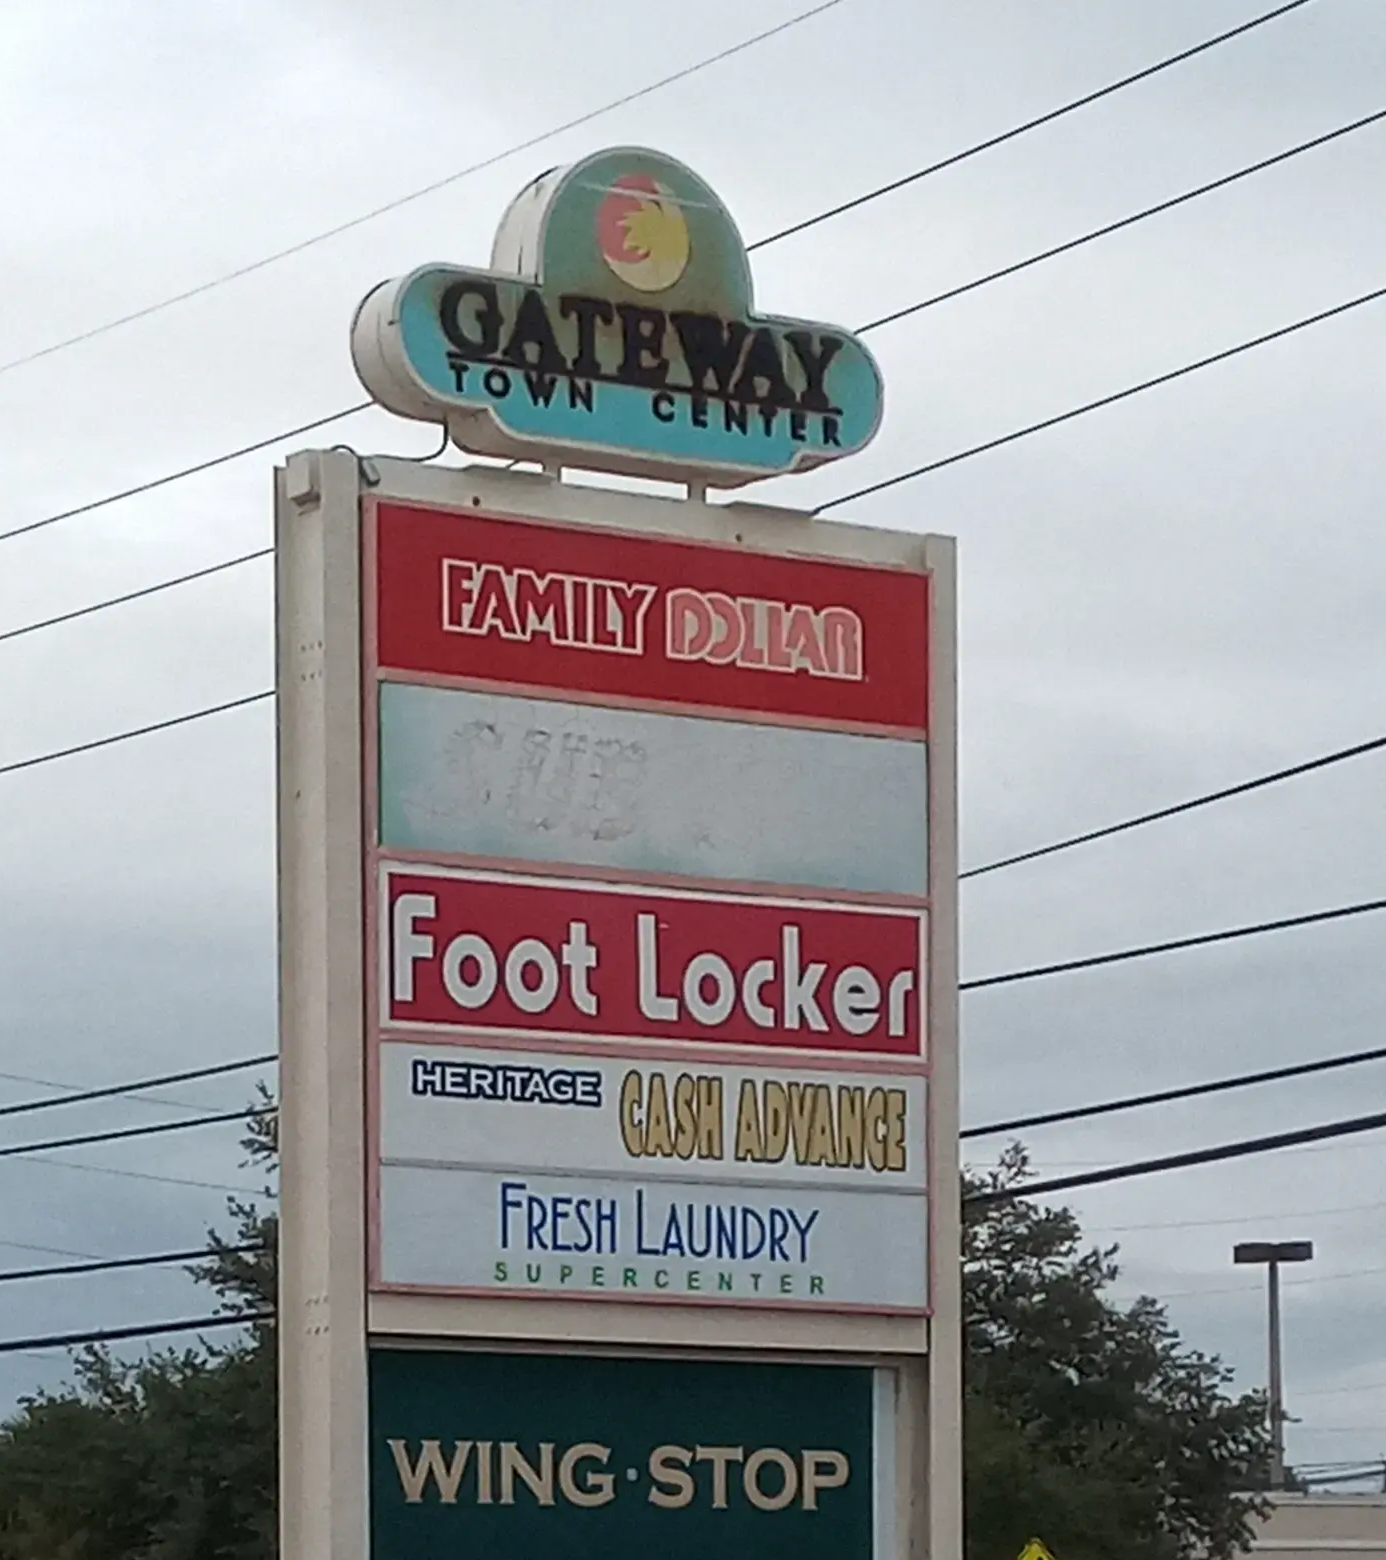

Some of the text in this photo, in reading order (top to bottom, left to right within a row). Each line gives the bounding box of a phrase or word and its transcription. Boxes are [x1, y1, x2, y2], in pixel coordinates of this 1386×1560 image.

[439, 280, 844, 411] GATEWAY
[448, 361, 844, 447] TOWN CENTER
[442, 559, 866, 681] FAMILY DOLLAR
[391, 893, 914, 1038] Foot Locker
[412, 1060, 602, 1105] HERITAGE
[620, 1070, 907, 1171] CASH ADVANCE
[499, 1182, 819, 1263] FRESH LAUNDRY
[494, 1261, 825, 1295] SUPERCENTER
